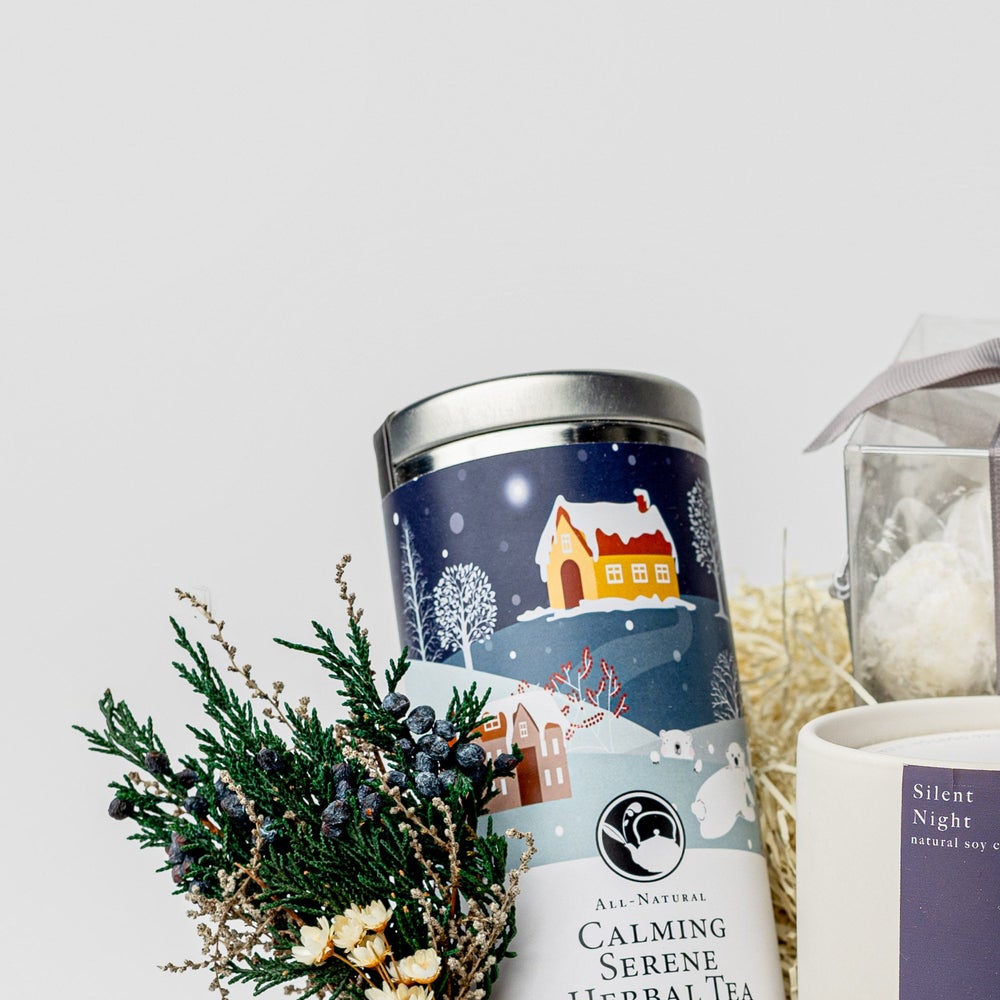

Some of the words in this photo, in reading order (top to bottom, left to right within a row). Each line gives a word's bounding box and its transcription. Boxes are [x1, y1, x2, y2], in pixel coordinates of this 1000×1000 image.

[913, 783, 974, 803] Silent
[912, 808, 972, 832] Night
[911, 836, 958, 848] natural
[964, 841, 987, 852] soy
